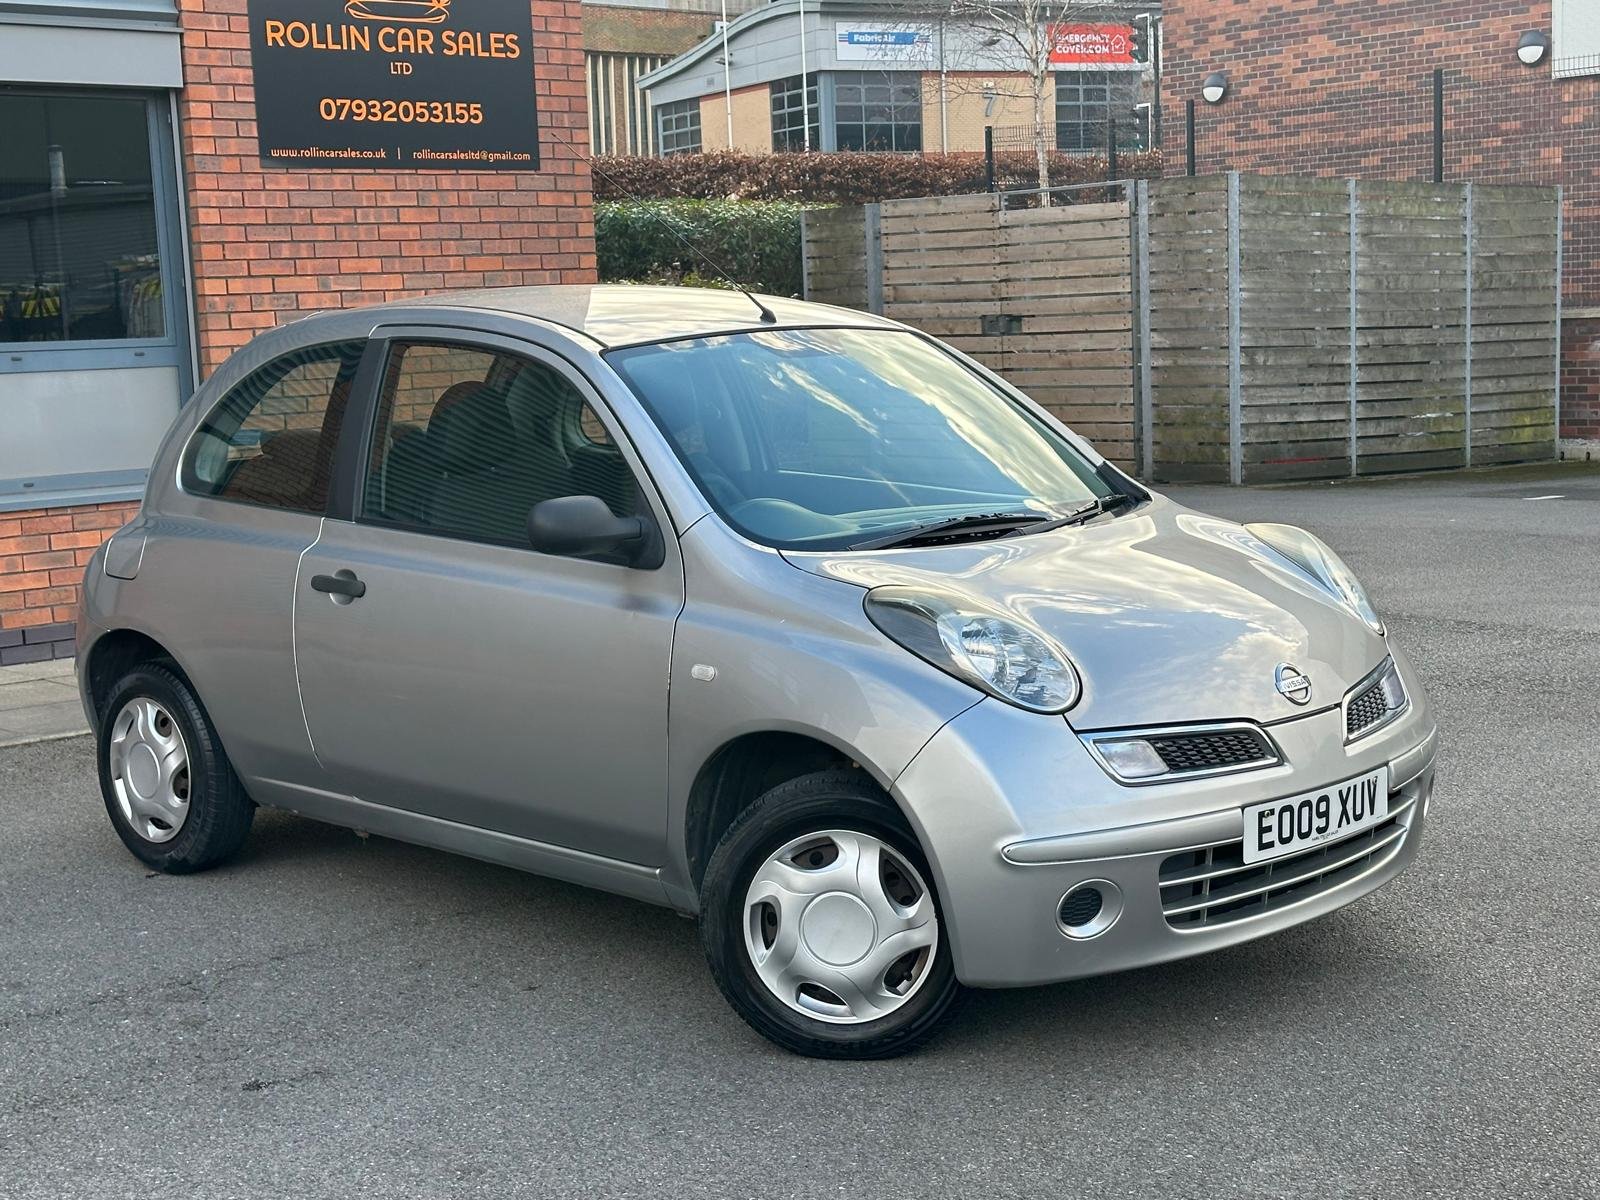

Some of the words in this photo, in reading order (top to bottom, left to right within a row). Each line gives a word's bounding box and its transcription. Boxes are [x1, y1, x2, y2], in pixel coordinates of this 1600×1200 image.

[265, 20, 370, 51] ROLLIN
[378, 27, 434, 54] CAR
[442, 31, 521, 59] SALES
[1055, 33, 1110, 44] EMERGENCY
[390, 62, 413, 75] LTD
[319, 98, 483, 124] 07932053155
[983, 90, 997, 117] 7
[271, 147, 386, 159] www.rollincarsales.co.uk
[413, 149, 531, 163] rollincarsalesltd@gmail.com
[1283, 677, 1309, 690] NISSA
[1337, 776, 1379, 829] XUV
